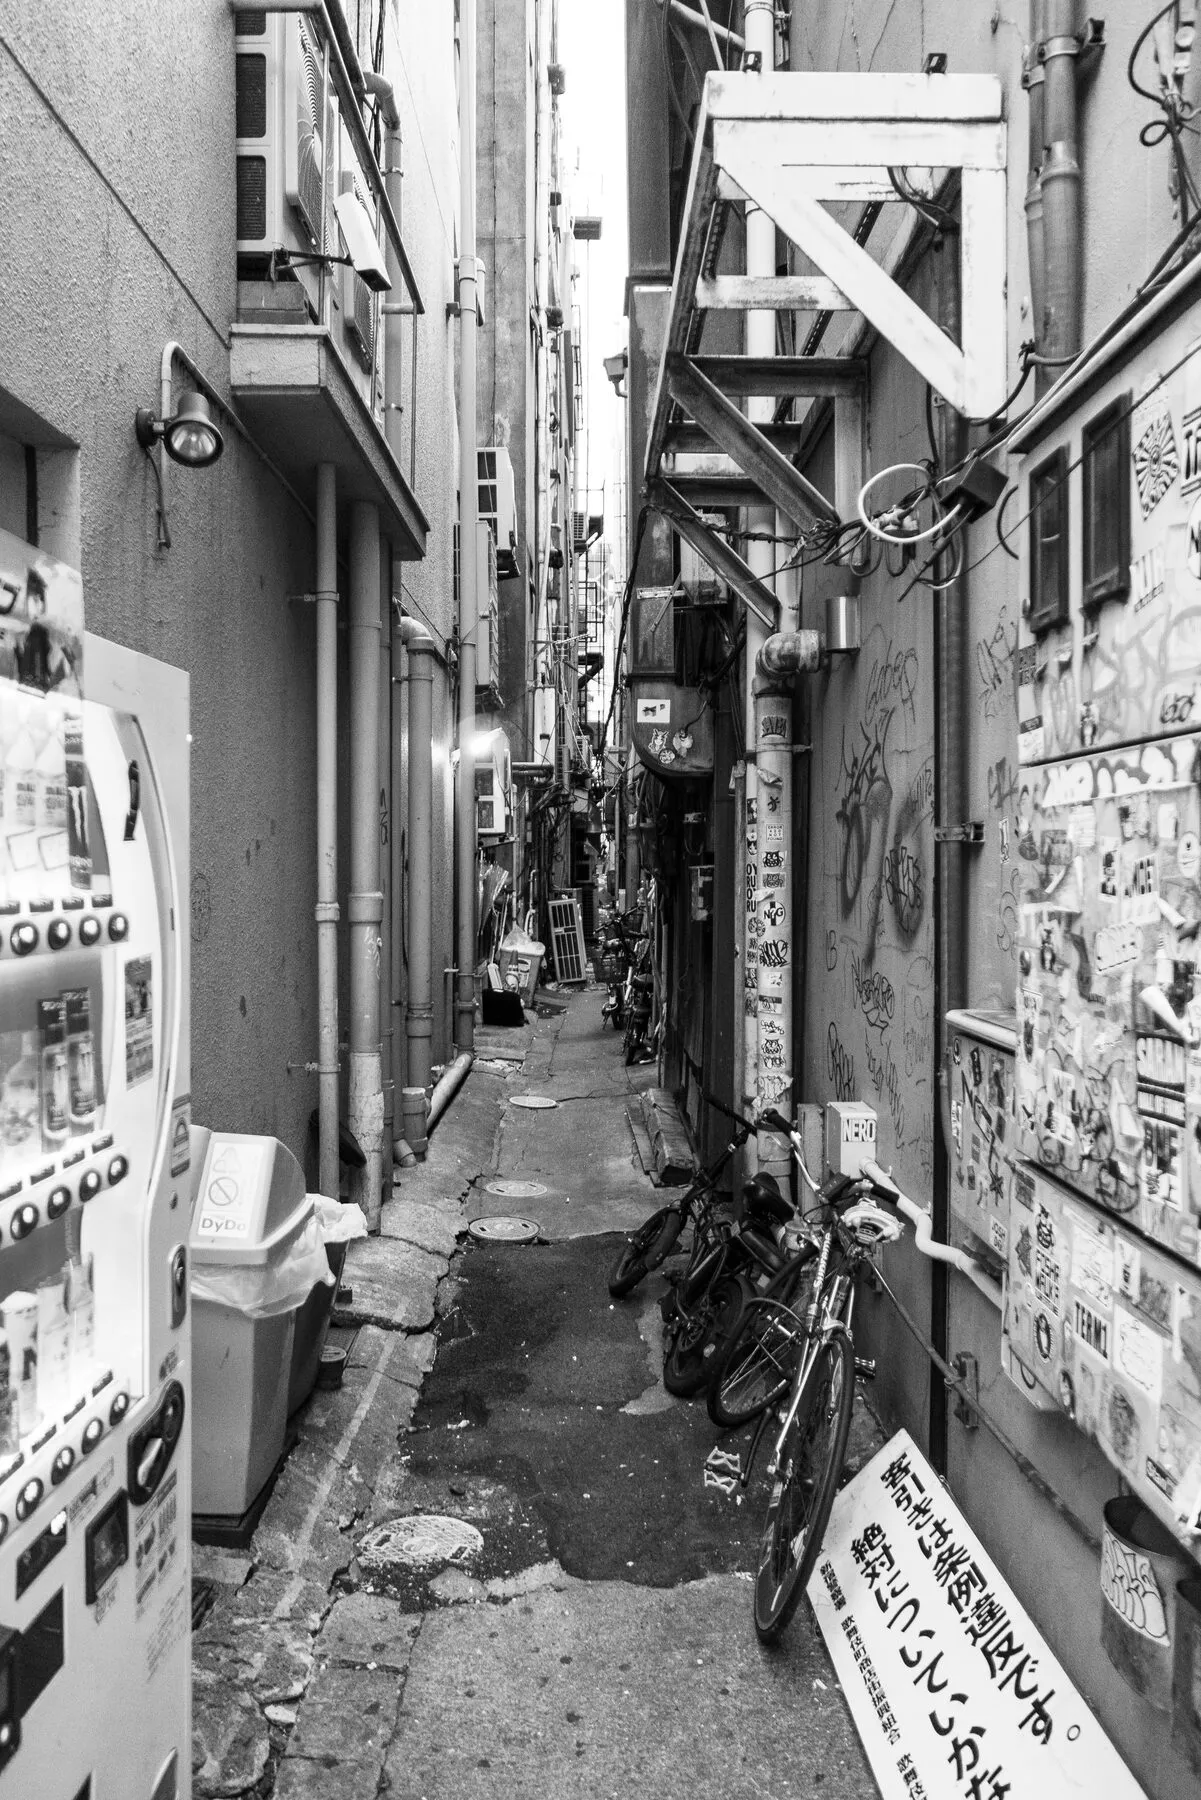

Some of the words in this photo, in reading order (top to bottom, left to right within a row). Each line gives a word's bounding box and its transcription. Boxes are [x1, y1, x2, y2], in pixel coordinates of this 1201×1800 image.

[843, 1119, 877, 1142] NERO
[202, 1218, 246, 1232] DyDo
[880, 1452, 1081, 1744] 客引きは条例違反です。
[896, 1752, 928, 1800] 歌舞伎
